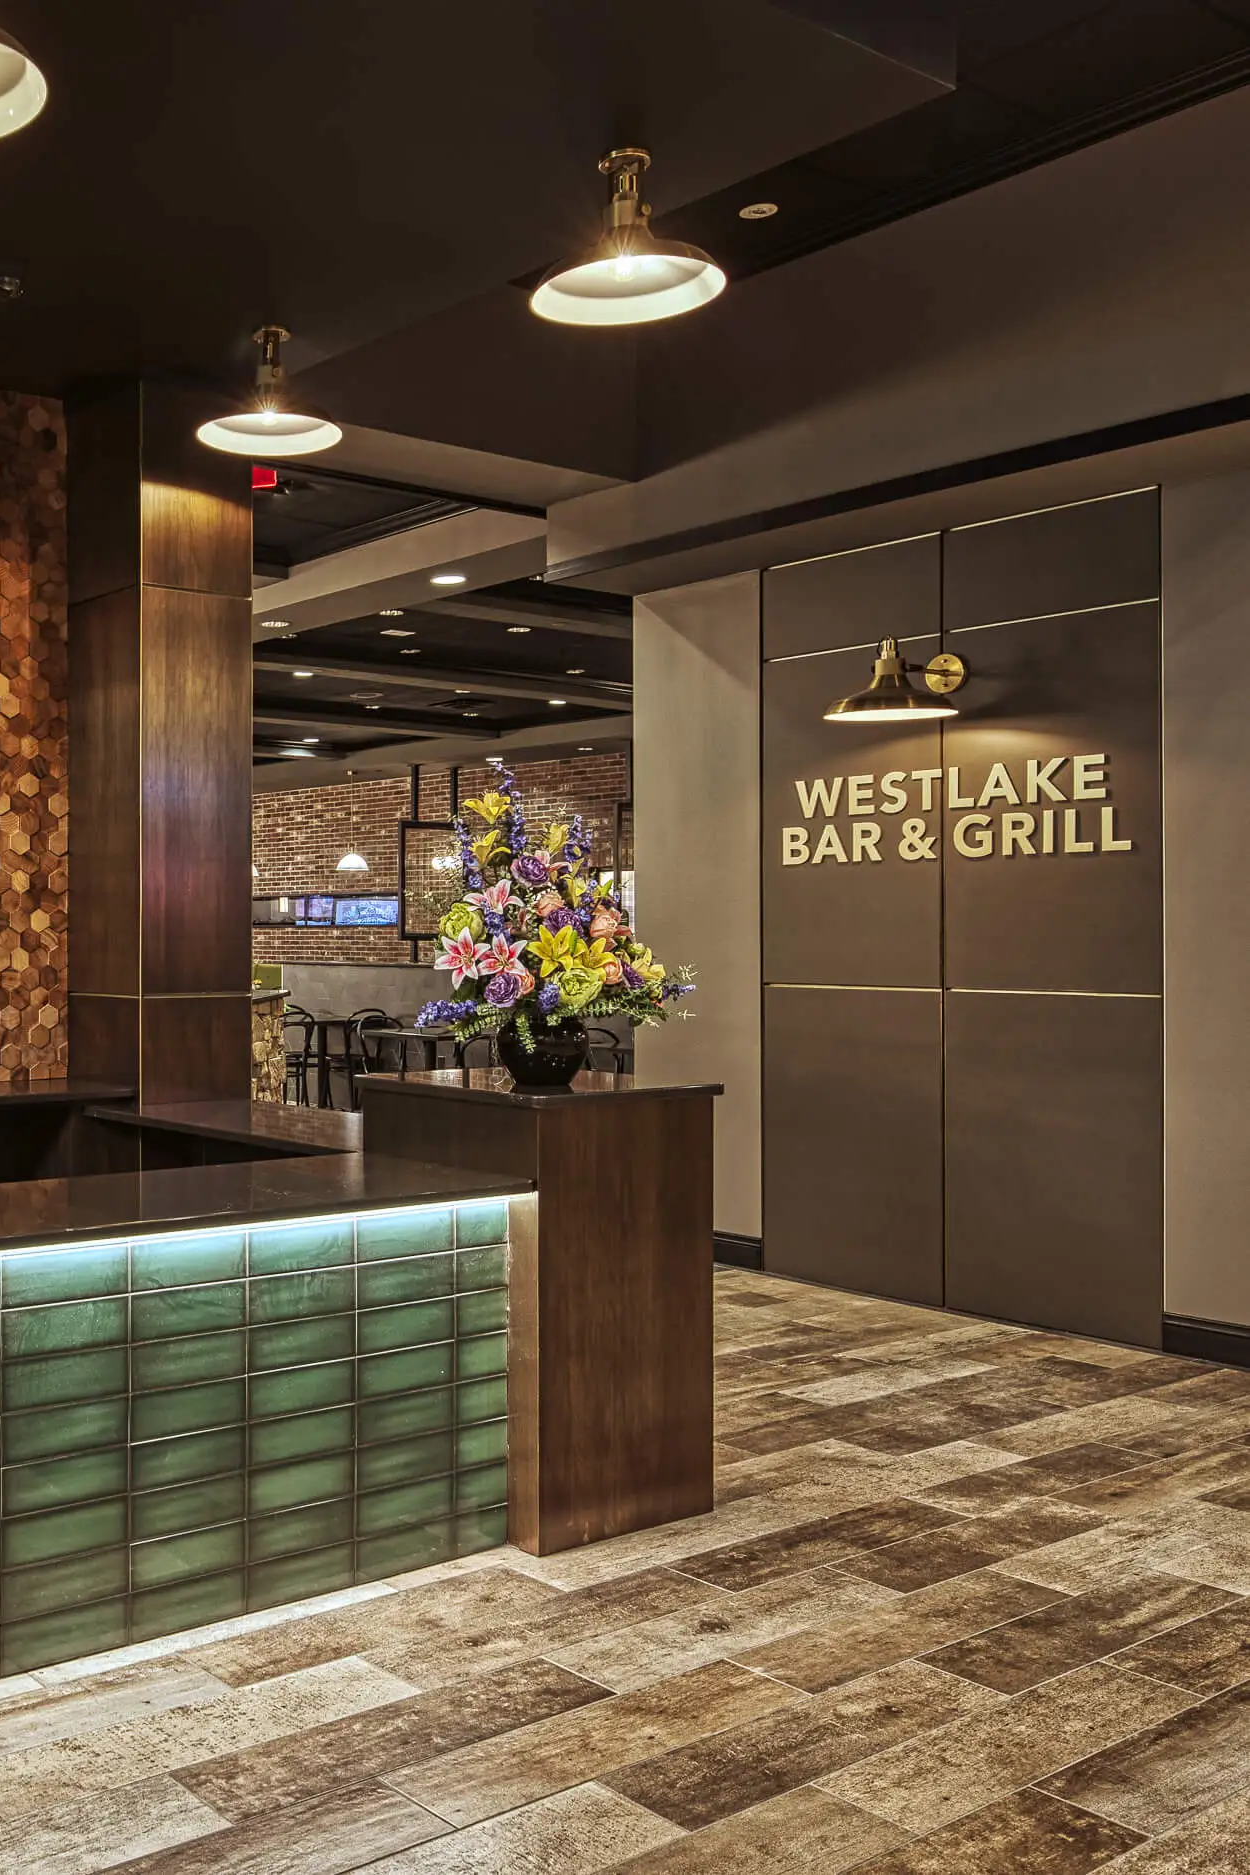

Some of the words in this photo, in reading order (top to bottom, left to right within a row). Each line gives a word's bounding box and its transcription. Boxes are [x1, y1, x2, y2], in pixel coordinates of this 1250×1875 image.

[795, 753, 1107, 818] WESTLAKE
[782, 822, 883, 865] BAR
[898, 818, 937, 860] &
[953, 806, 1132, 857] GRILL
